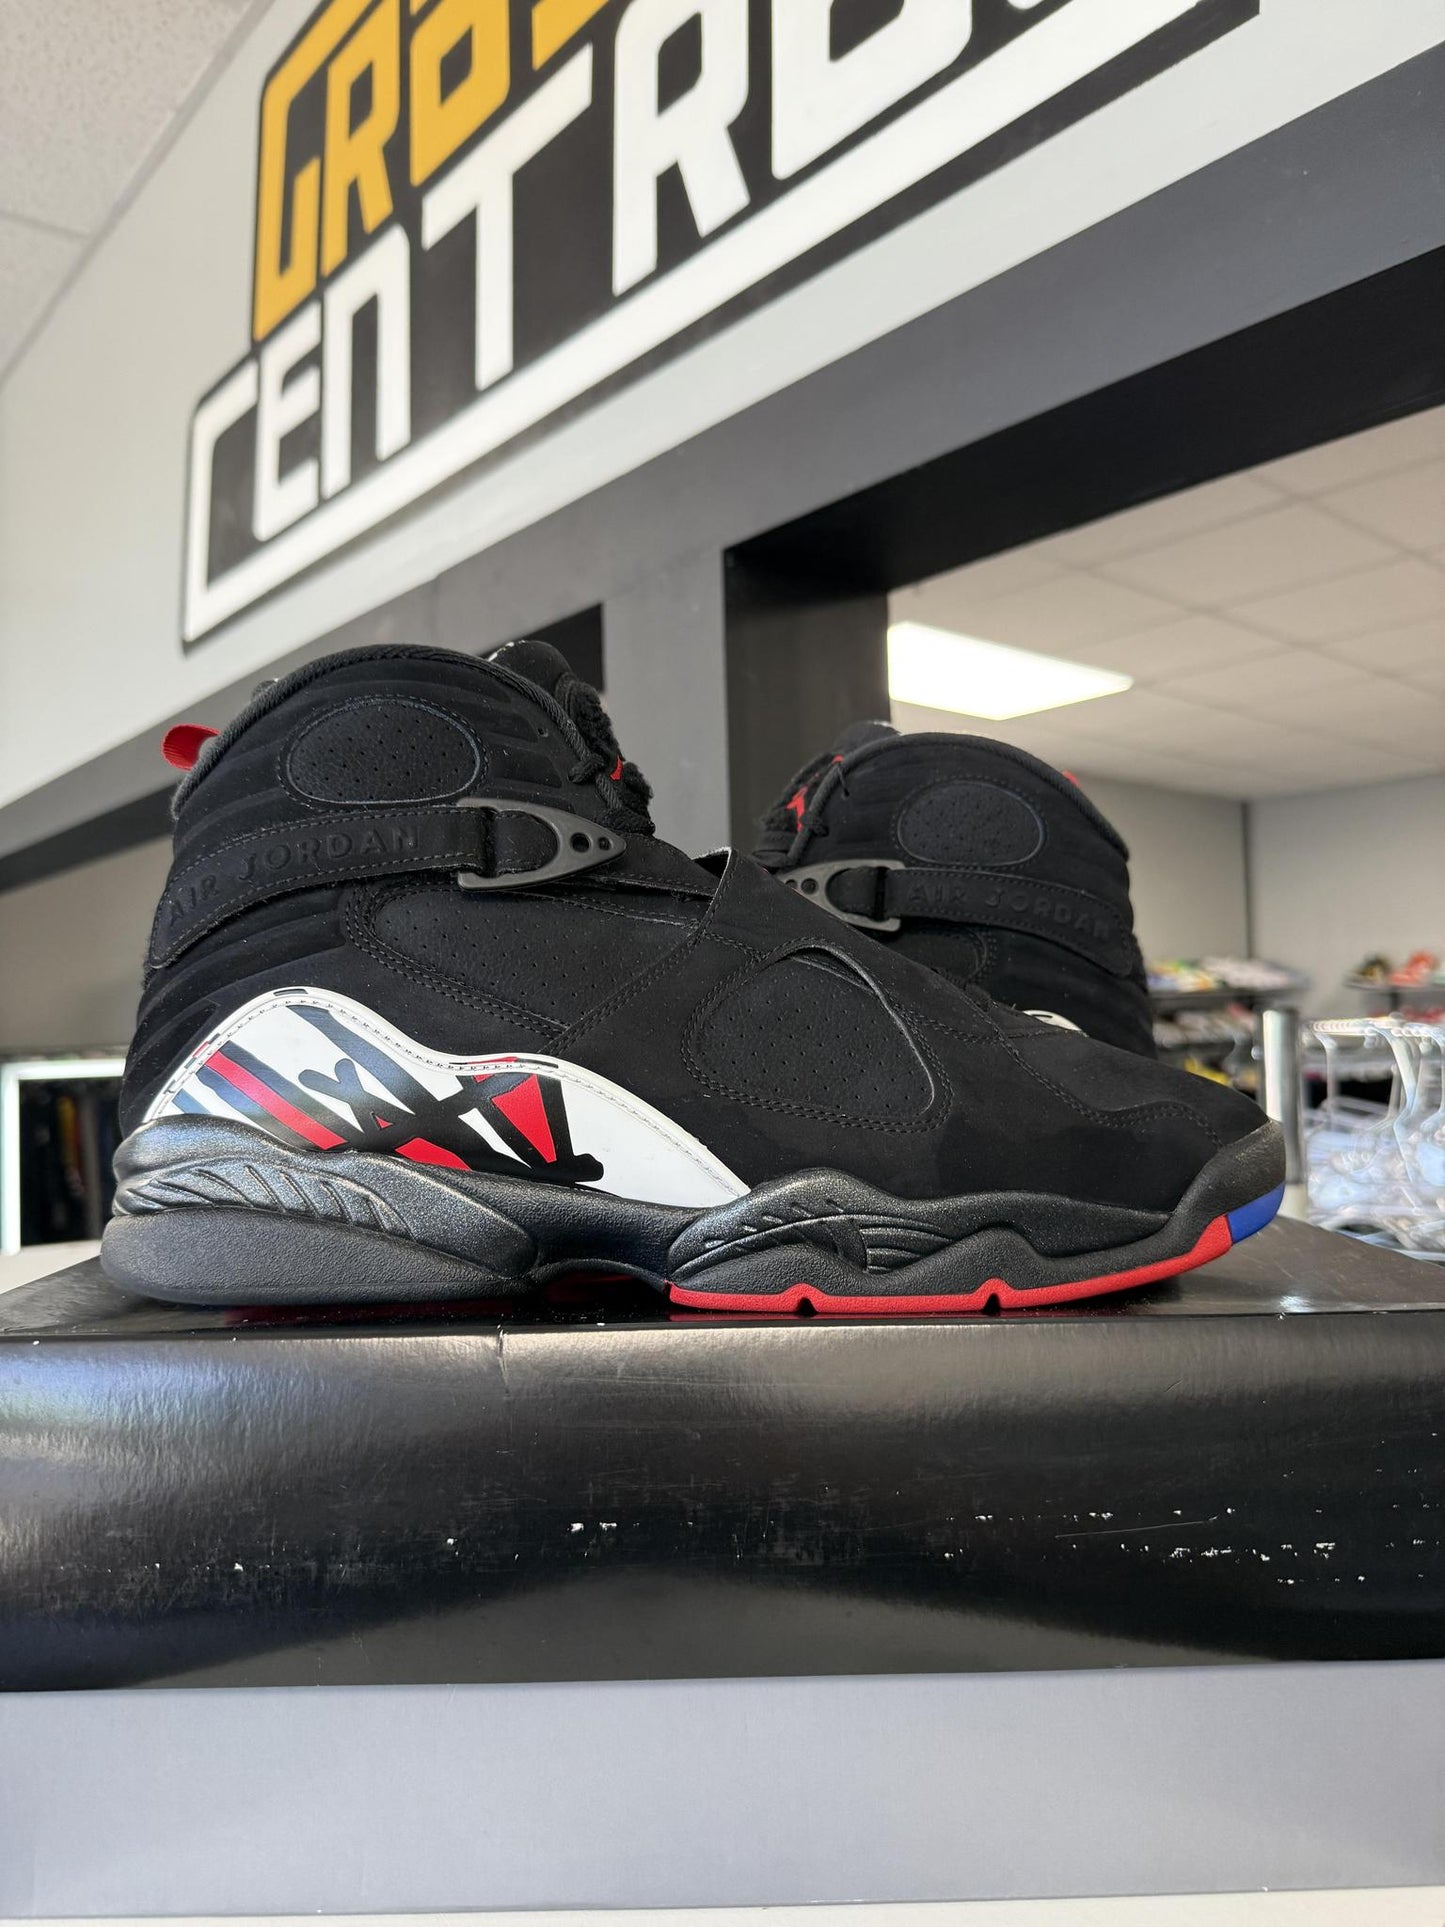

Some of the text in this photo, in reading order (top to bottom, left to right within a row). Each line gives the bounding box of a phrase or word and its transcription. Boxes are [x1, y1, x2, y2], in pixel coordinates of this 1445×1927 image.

[167, 827, 420, 927] AIR JORDAN
[907, 883, 1109, 939] AIR JORDAN
